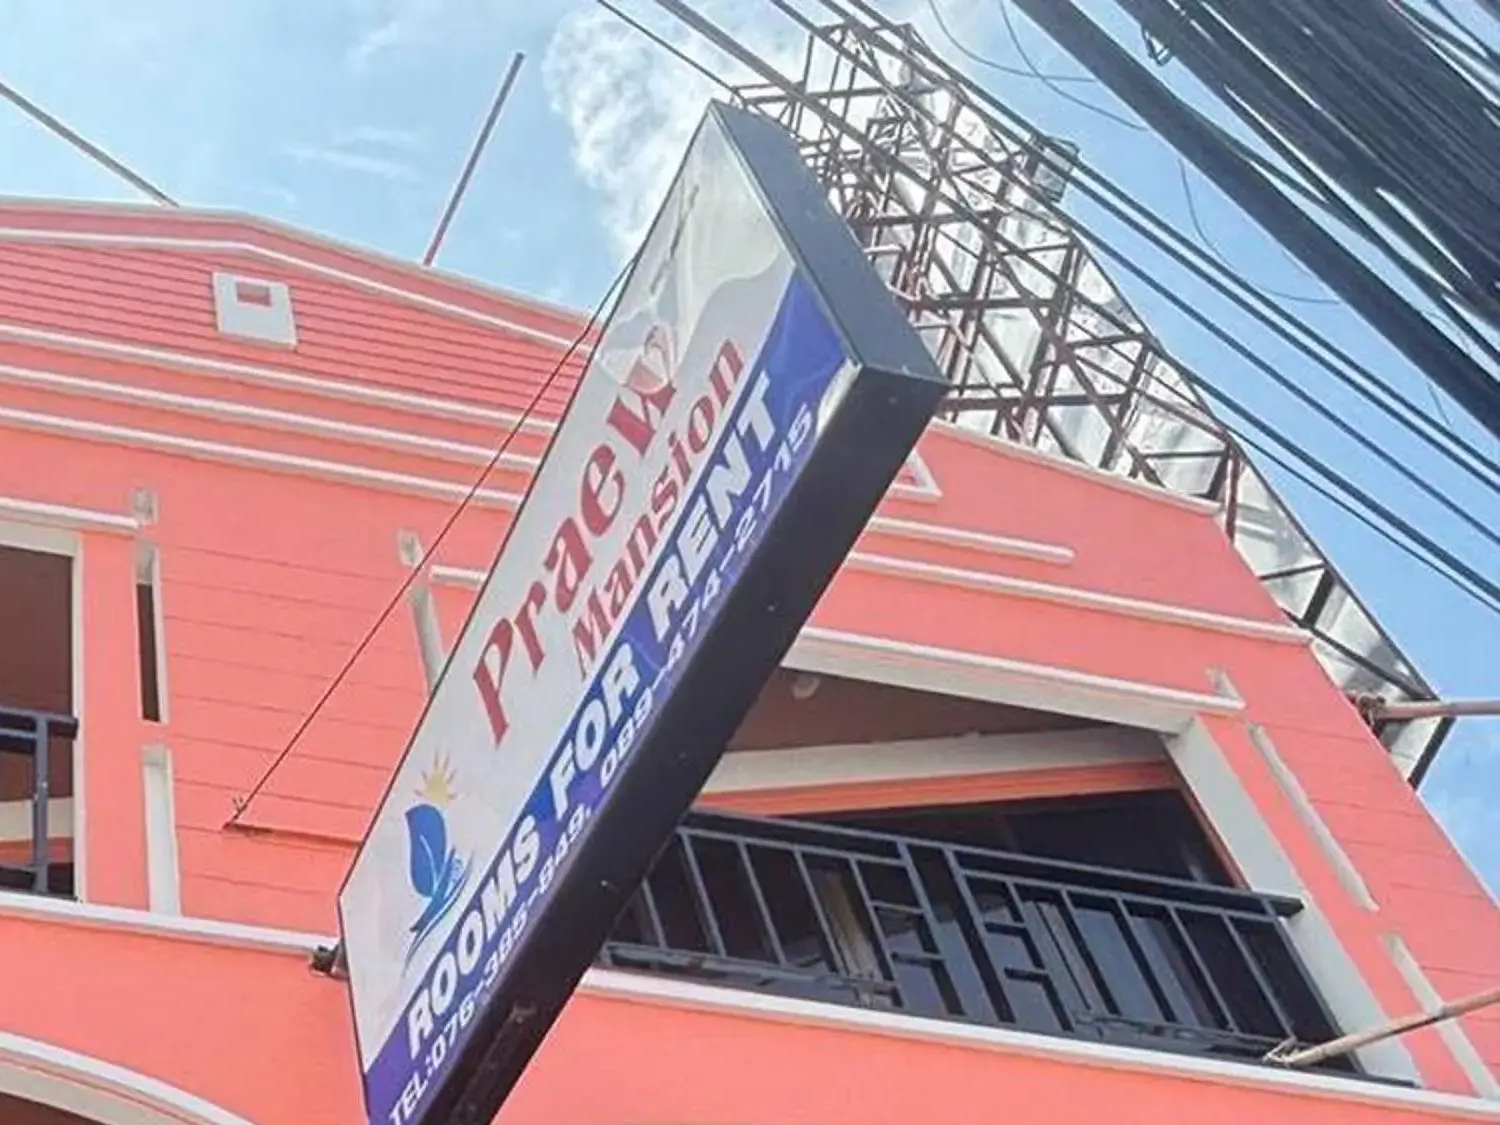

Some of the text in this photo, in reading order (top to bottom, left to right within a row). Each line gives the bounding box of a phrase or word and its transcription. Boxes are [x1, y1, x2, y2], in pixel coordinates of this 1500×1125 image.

[407, 370, 776, 1060] ROOMS FOR RENT
[472, 325, 678, 748] Praew
[571, 338, 744, 681] Mansion
